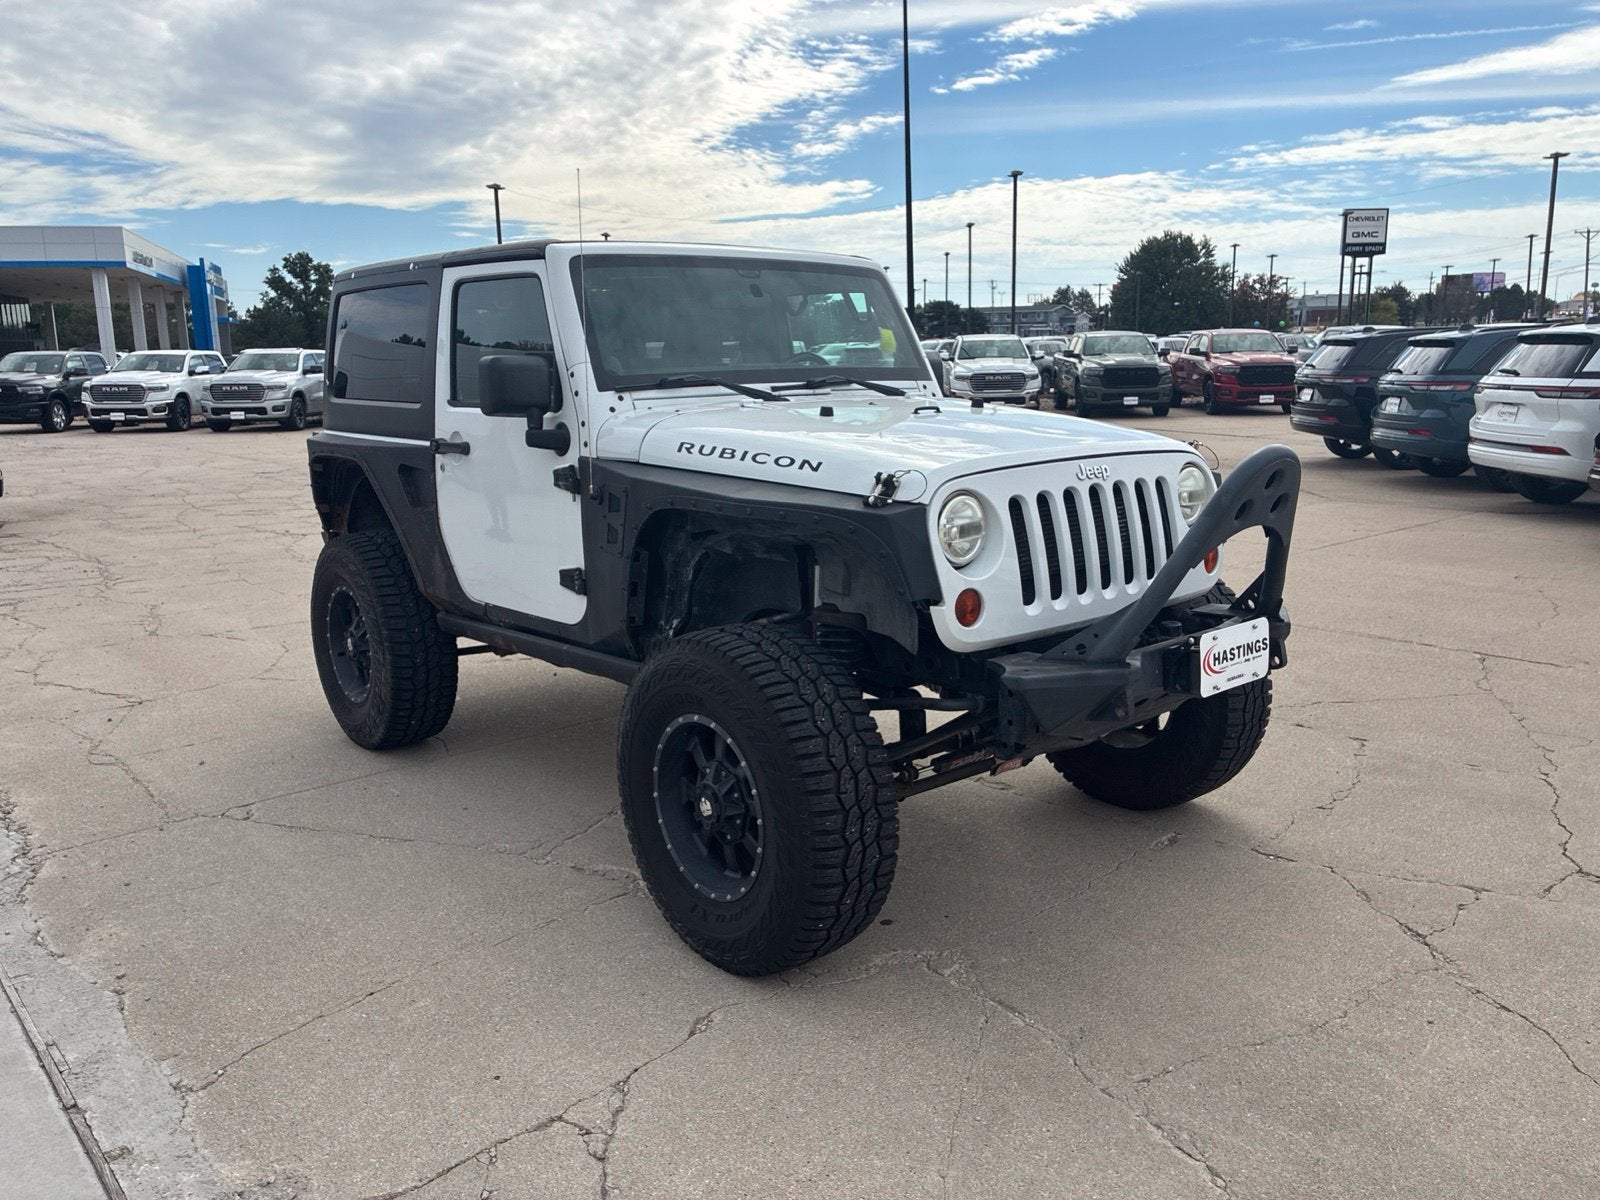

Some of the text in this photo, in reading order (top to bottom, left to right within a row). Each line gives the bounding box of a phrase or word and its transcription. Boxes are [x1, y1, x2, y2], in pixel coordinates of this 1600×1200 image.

[676, 441, 823, 473] RUBICON
[1076, 463, 1110, 481] Jeep
[1213, 637, 1268, 667] HASTINGS
